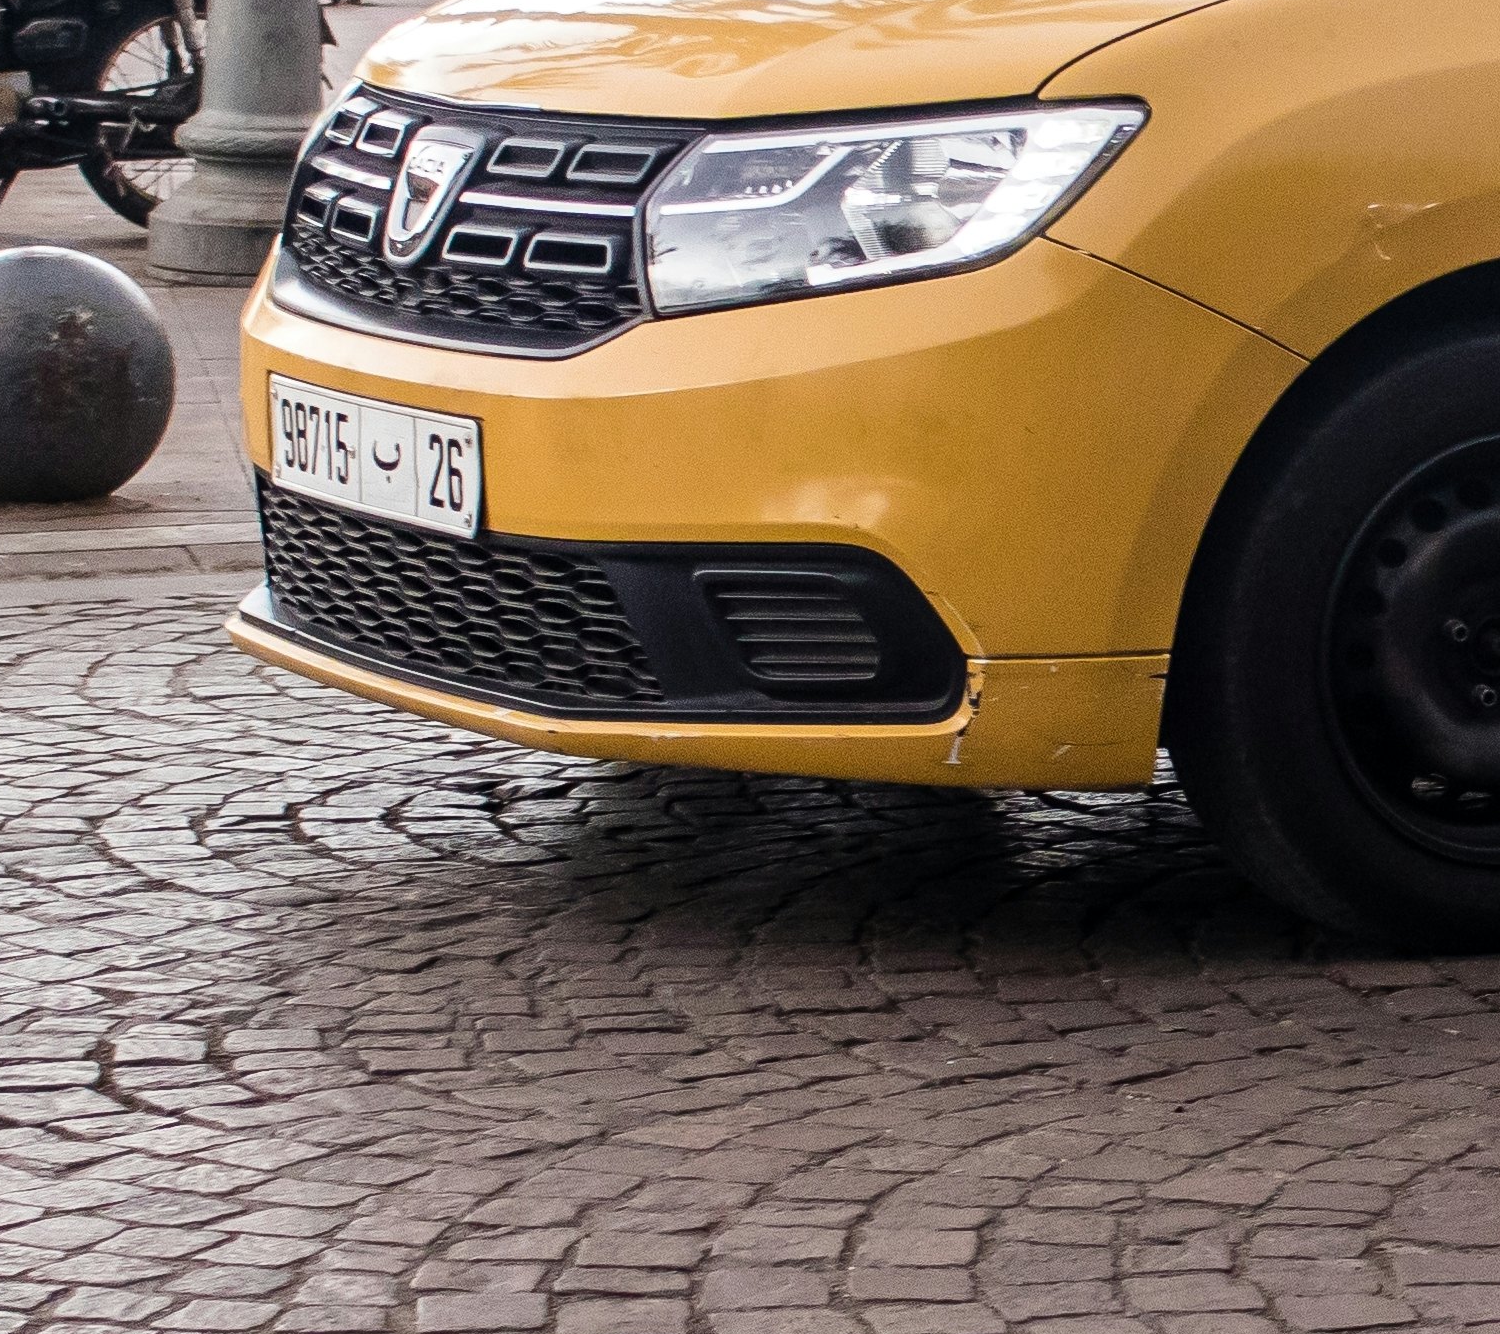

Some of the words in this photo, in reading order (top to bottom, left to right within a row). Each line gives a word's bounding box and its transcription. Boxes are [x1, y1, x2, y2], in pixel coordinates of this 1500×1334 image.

[281, 398, 349, 485] 98715
[372, 440, 401, 484] ب
[429, 433, 464, 512] 26
